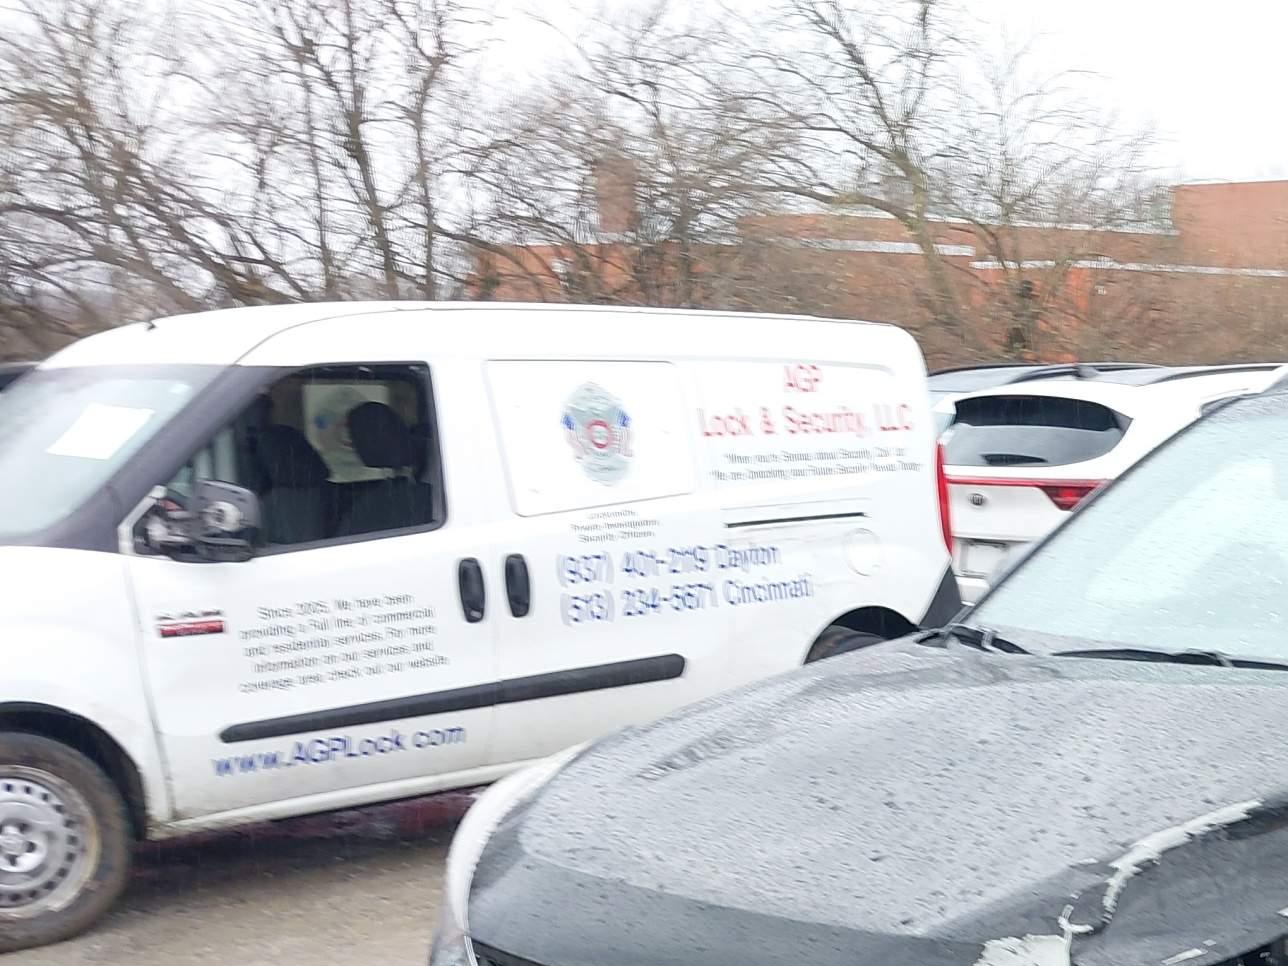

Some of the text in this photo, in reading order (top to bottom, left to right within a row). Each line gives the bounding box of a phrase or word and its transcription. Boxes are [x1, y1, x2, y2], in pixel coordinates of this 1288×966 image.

[698, 407, 752, 436] Lock
[761, 406, 776, 434] &
[873, 403, 913, 431] LLC
[557, 550, 615, 588] (937)
[714, 544, 780, 573] Dayton
